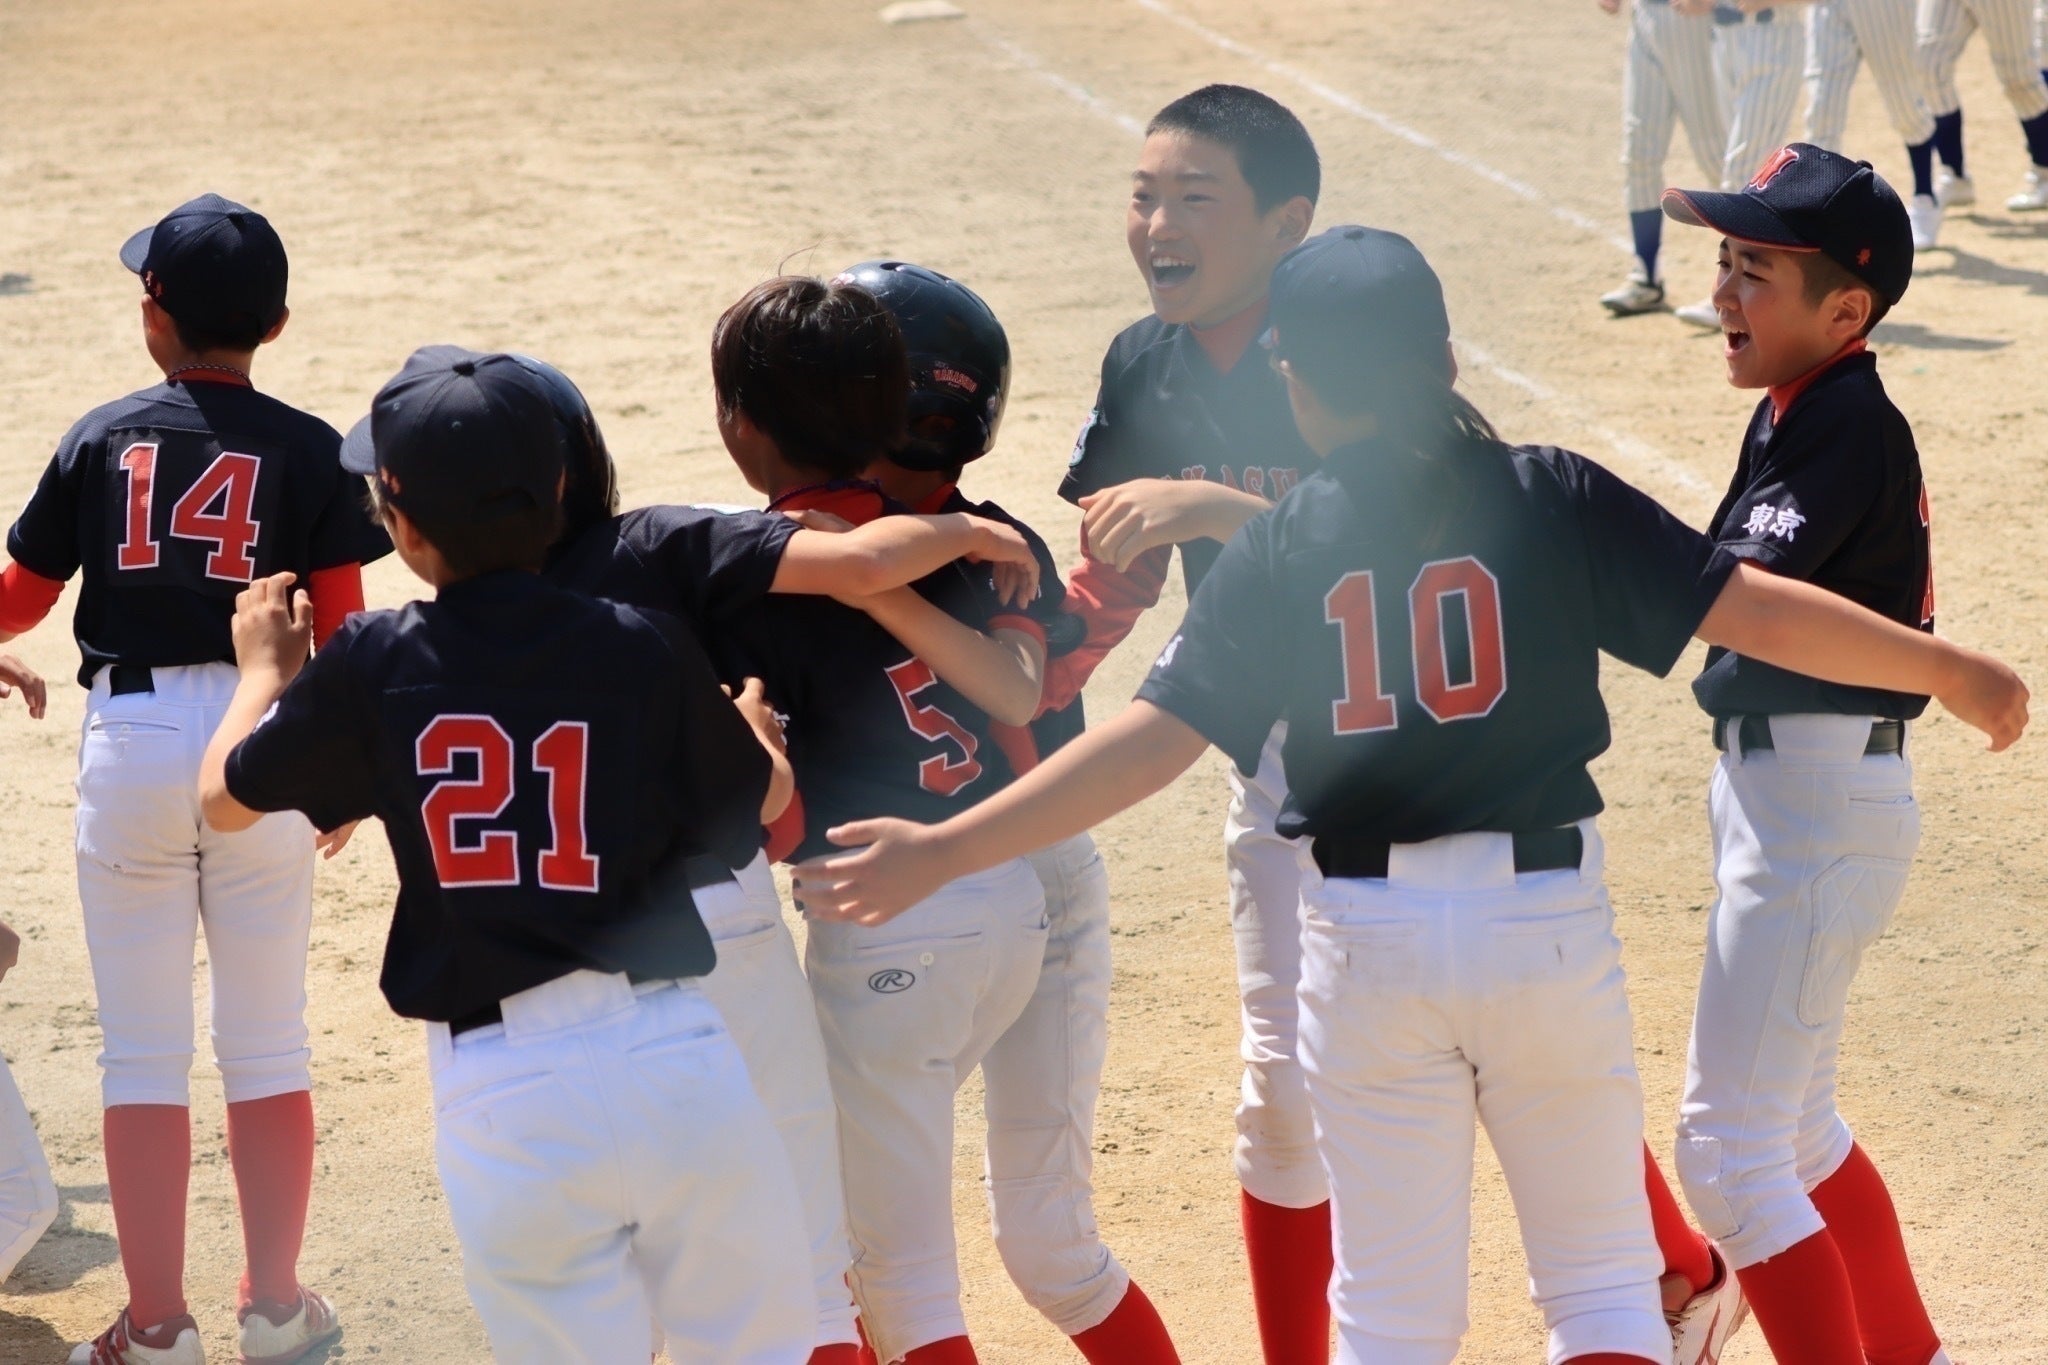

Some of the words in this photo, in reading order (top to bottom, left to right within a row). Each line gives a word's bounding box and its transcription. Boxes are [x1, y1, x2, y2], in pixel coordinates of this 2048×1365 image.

[118, 442, 261, 583] 14
[1742, 503, 1807, 542] 東京
[1324, 555, 1507, 736] 10
[884, 656, 982, 797] 5
[415, 714, 600, 893] 21
